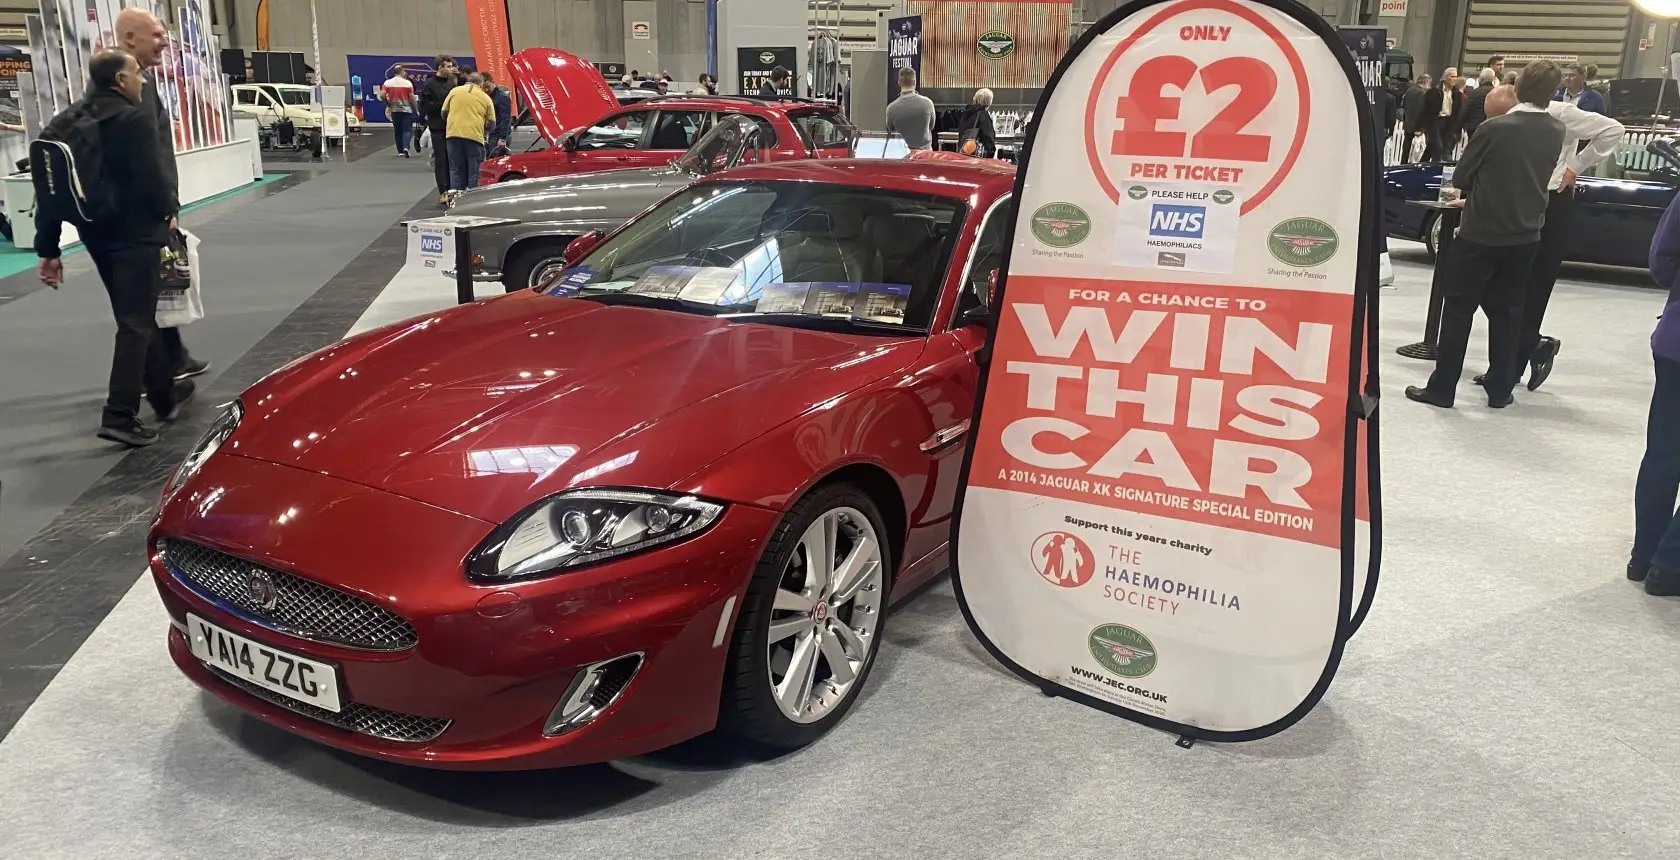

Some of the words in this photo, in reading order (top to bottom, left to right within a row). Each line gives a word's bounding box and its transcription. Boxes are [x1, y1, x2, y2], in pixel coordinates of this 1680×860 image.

[1382, 1, 1405, 11] point
[985, 32, 1007, 40] JAGUAR
[1180, 26, 1232, 41] ONLY
[889, 36, 918, 57] JAGUAR
[892, 57, 912, 68] FESTIVAL
[743, 77, 792, 89] EXPT
[1111, 54, 1278, 162] £2
[1130, 163, 1168, 178] PER
[1173, 164, 1244, 182] TICKET
[1152, 190, 1184, 199] PLEASE
[1186, 192, 1209, 200] HELP
[1151, 211, 1204, 233] NHS
[1286, 221, 1325, 232] JAGUAR
[421, 238, 442, 250] NHS
[1032, 249, 1053, 257] Sharing
[1147, 240, 1202, 250] HAEMOPHILIACS
[1267, 268, 1291, 277] Sharing
[1068, 289, 1110, 302] FOR
[1116, 290, 1132, 303] A
[1138, 292, 1229, 309] CHANCE
[1235, 298, 1267, 311] TO
[1011, 303, 1334, 384] WIN
[1006, 360, 1325, 441] THIS
[1000, 416, 1314, 510] CAR
[998, 468, 1007, 480] A
[1009, 470, 1038, 485] 2014
[1039, 474, 1090, 493] JAGUAR
[1092, 483, 1111, 497] XK
[1113, 486, 1189, 510] SIGNATURE
[1192, 499, 1251, 520] SPECIAL
[1254, 508, 1314, 532] EDITION
[1064, 515, 1109, 531] Support
[1111, 526, 1133, 537] this
[1135, 531, 1167, 545] years
[1169, 539, 1213, 556] charity
[1108, 545, 1142, 566] THE
[1105, 565, 1241, 611] HAEMOPHILIA
[1103, 584, 1180, 616] SOCIETY
[1106, 626, 1143, 645] JAGUAR
[200, 623, 255, 675] YA14
[260, 650, 318, 697] ZZG
[1071, 666, 1168, 703] WWW.JEC.ORG.UK
